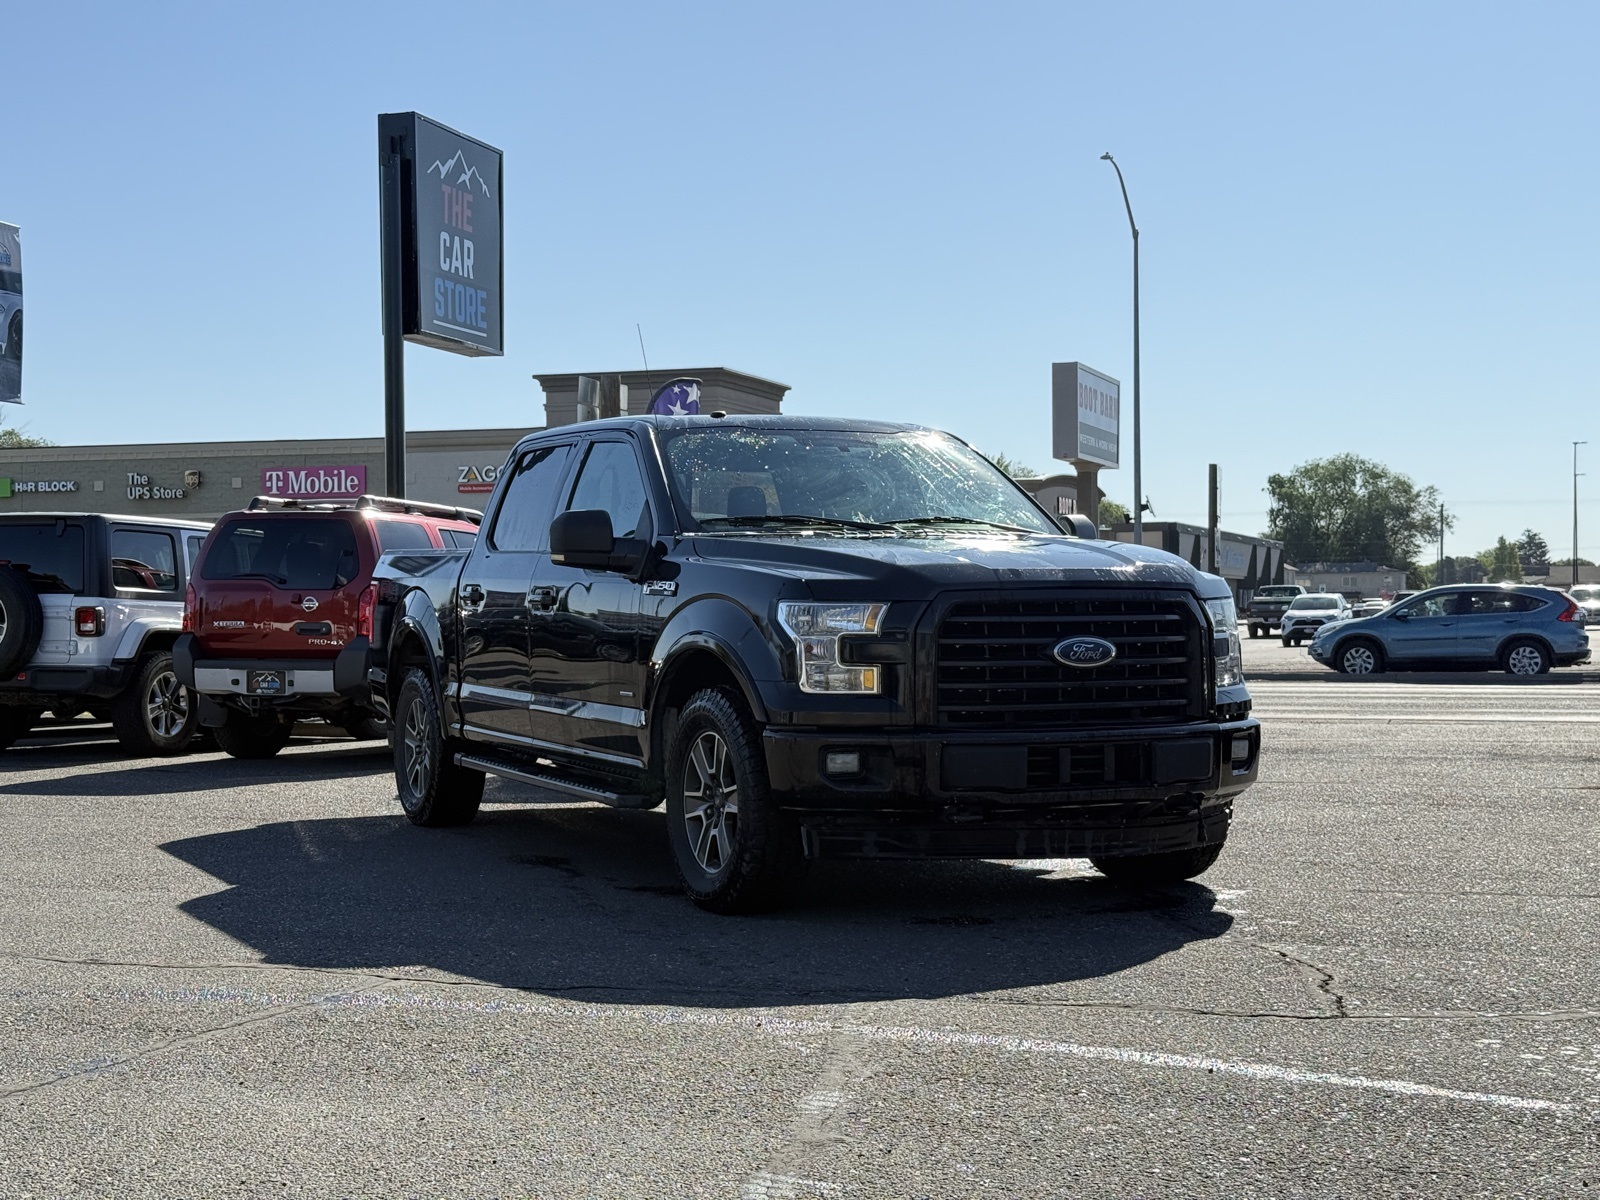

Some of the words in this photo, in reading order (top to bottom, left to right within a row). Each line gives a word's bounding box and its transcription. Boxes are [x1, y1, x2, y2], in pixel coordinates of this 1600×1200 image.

[442, 184, 473, 233] THE
[440, 231, 474, 279] CAR
[434, 277, 487, 329] STORE
[1079, 382, 1098, 413] BOOT
[15, 482, 35, 492] H&R
[38, 481, 76, 492] BLOCK
[127, 473, 148, 485] The
[287, 469, 359, 494] Mobile
[127, 487, 150, 499] UPS
[153, 487, 183, 499] Store
[1069, 643, 1103, 660] Ford
